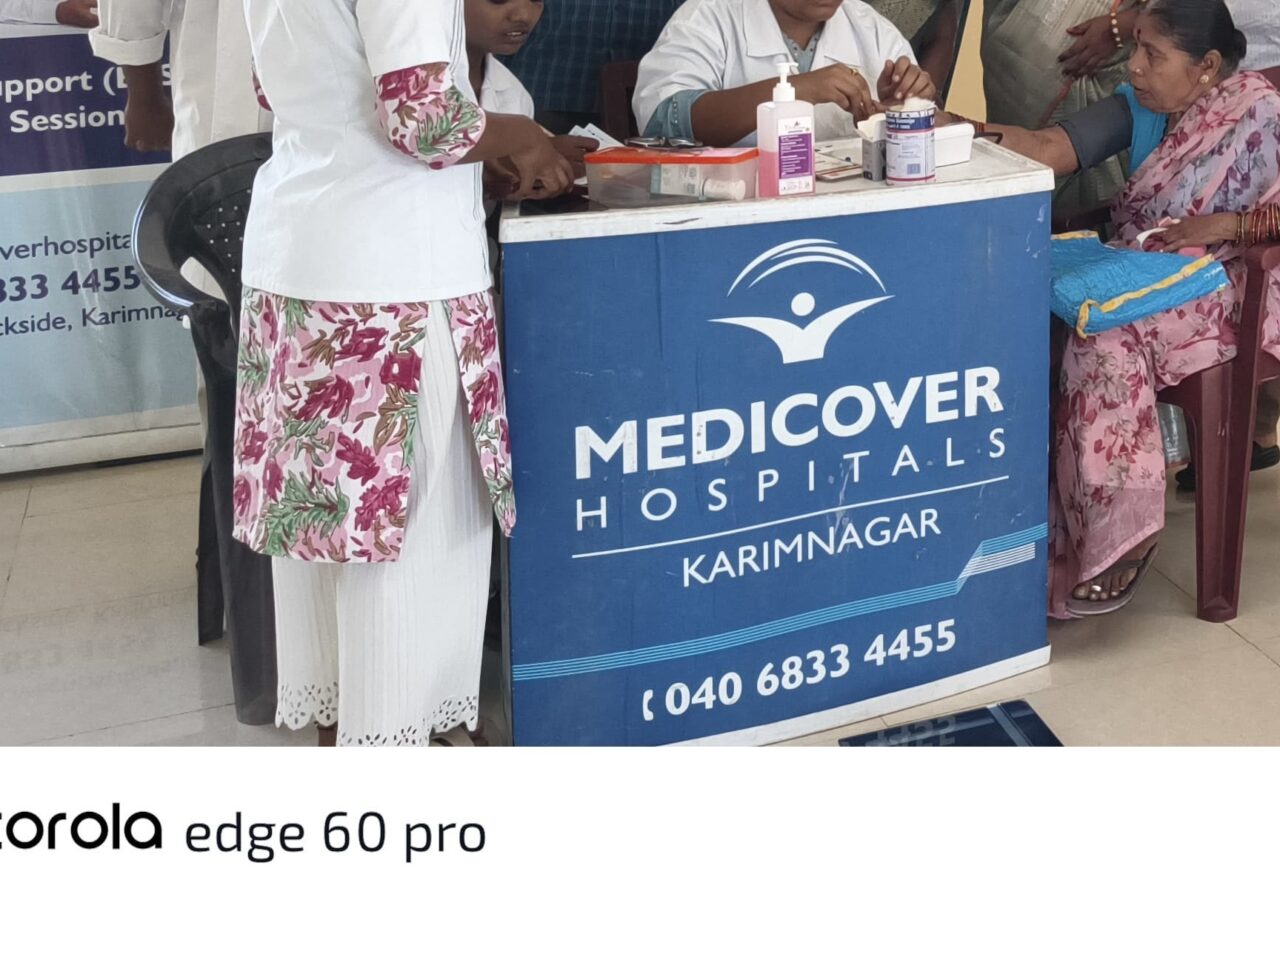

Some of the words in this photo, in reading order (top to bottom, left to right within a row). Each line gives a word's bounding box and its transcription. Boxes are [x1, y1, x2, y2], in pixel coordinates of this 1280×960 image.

[0, 71, 93, 103] pport
[9, 105, 126, 133] Session
[61, 265, 141, 295] 4455
[574, 366, 1004, 479] MEDICOVER
[576, 428, 1007, 531] HOSPITALS
[682, 508, 942, 588] KARIMNAGAR
[665, 671, 742, 716] 040
[756, 643, 850, 696] 6833
[863, 618, 956, 666] 4455
